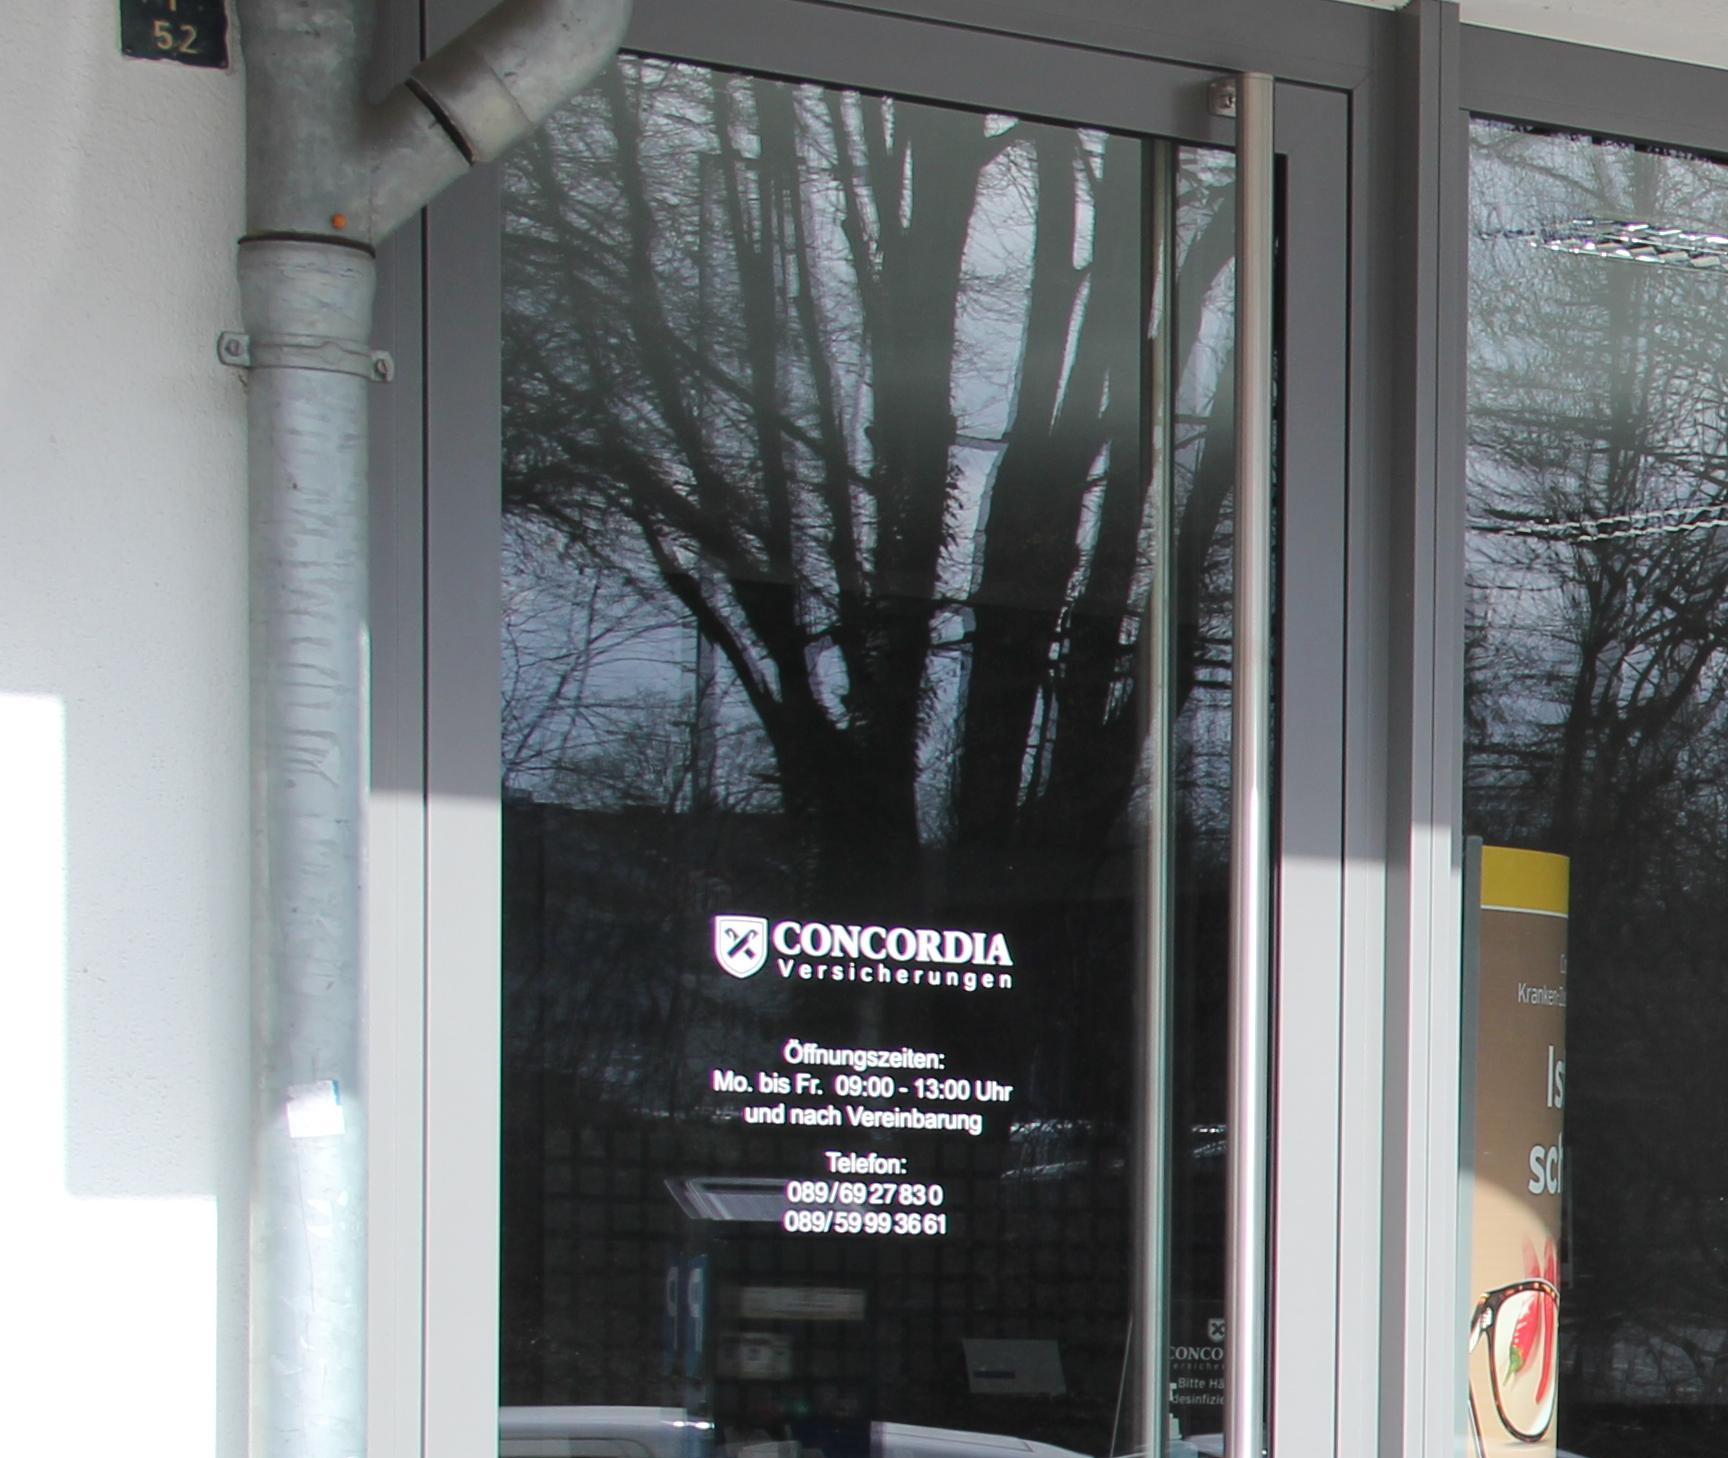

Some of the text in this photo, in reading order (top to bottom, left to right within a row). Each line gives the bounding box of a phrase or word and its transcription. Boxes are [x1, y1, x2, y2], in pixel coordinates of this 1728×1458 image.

[773, 921, 1013, 966] CONCORDIA
[777, 958, 1013, 991] Versicherungen
[784, 1039, 945, 1071] Öffnungszeiten:
[713, 1070, 752, 1093] Mo.
[759, 1071, 790, 1094] bis
[796, 1073, 823, 1095] Fr.
[835, 1075, 894, 1098] 09:00
[914, 1077, 970, 1101] 13:00
[976, 1080, 1013, 1102] Uhr
[745, 1102, 983, 1136] und nach Vereinbarung
[825, 1151, 907, 1175] Telefon:
